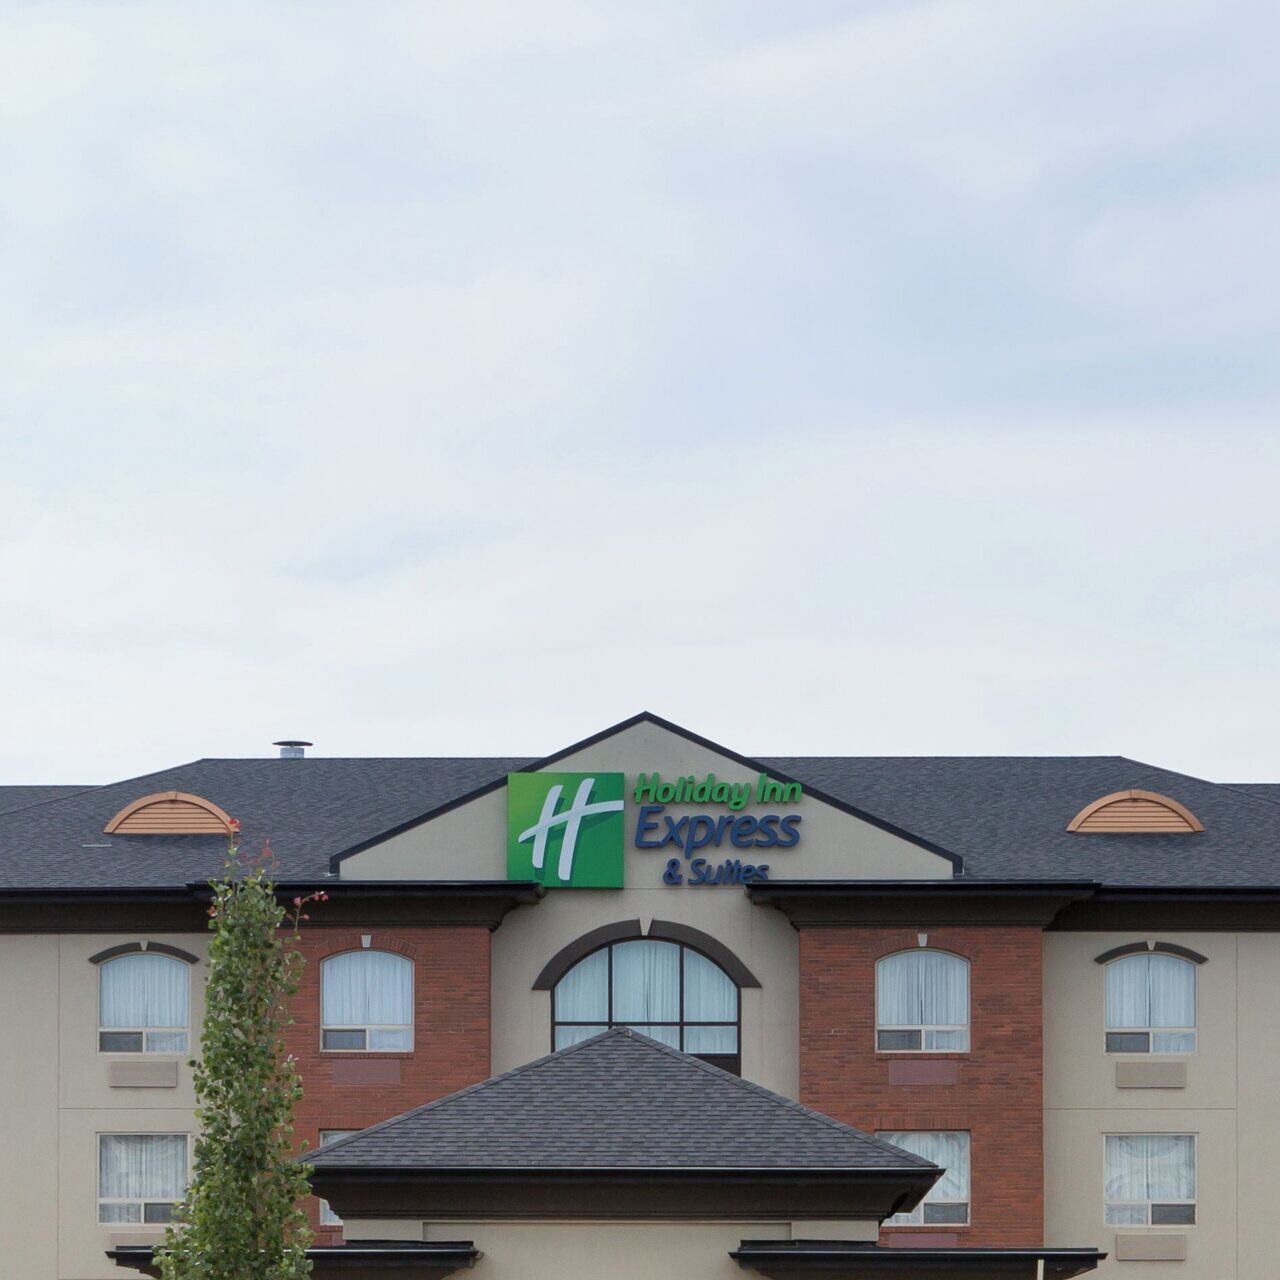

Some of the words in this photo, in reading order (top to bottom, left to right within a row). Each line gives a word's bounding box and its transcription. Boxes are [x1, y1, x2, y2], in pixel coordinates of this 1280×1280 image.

[633, 773, 750, 811] Holiday
[756, 773, 803, 804] Inn
[634, 805, 802, 860] Express
[662, 858, 683, 885] &
[688, 858, 770, 886] Suites
